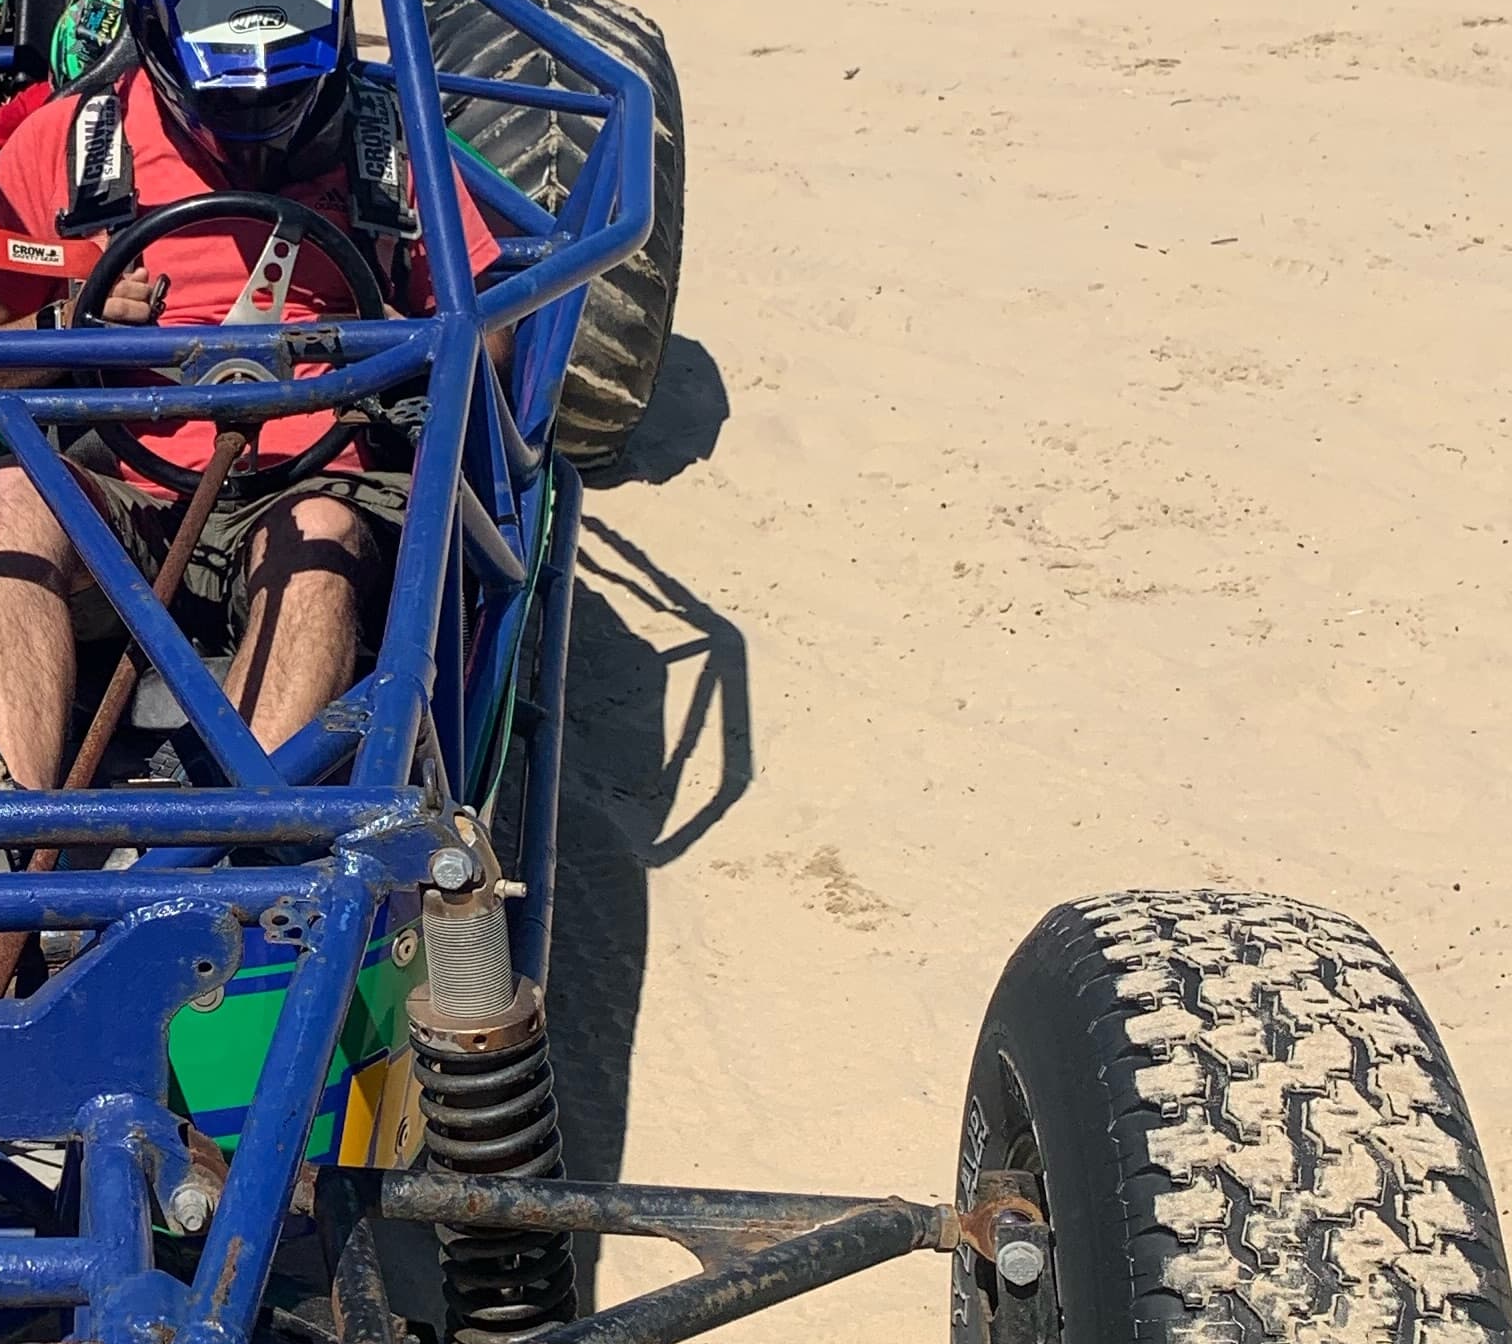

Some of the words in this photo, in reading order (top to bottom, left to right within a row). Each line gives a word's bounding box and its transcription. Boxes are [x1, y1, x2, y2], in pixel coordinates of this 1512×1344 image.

[84, 120, 105, 180] CROW
[359, 115, 385, 178] CROW
[12, 244, 45, 257] CROW
